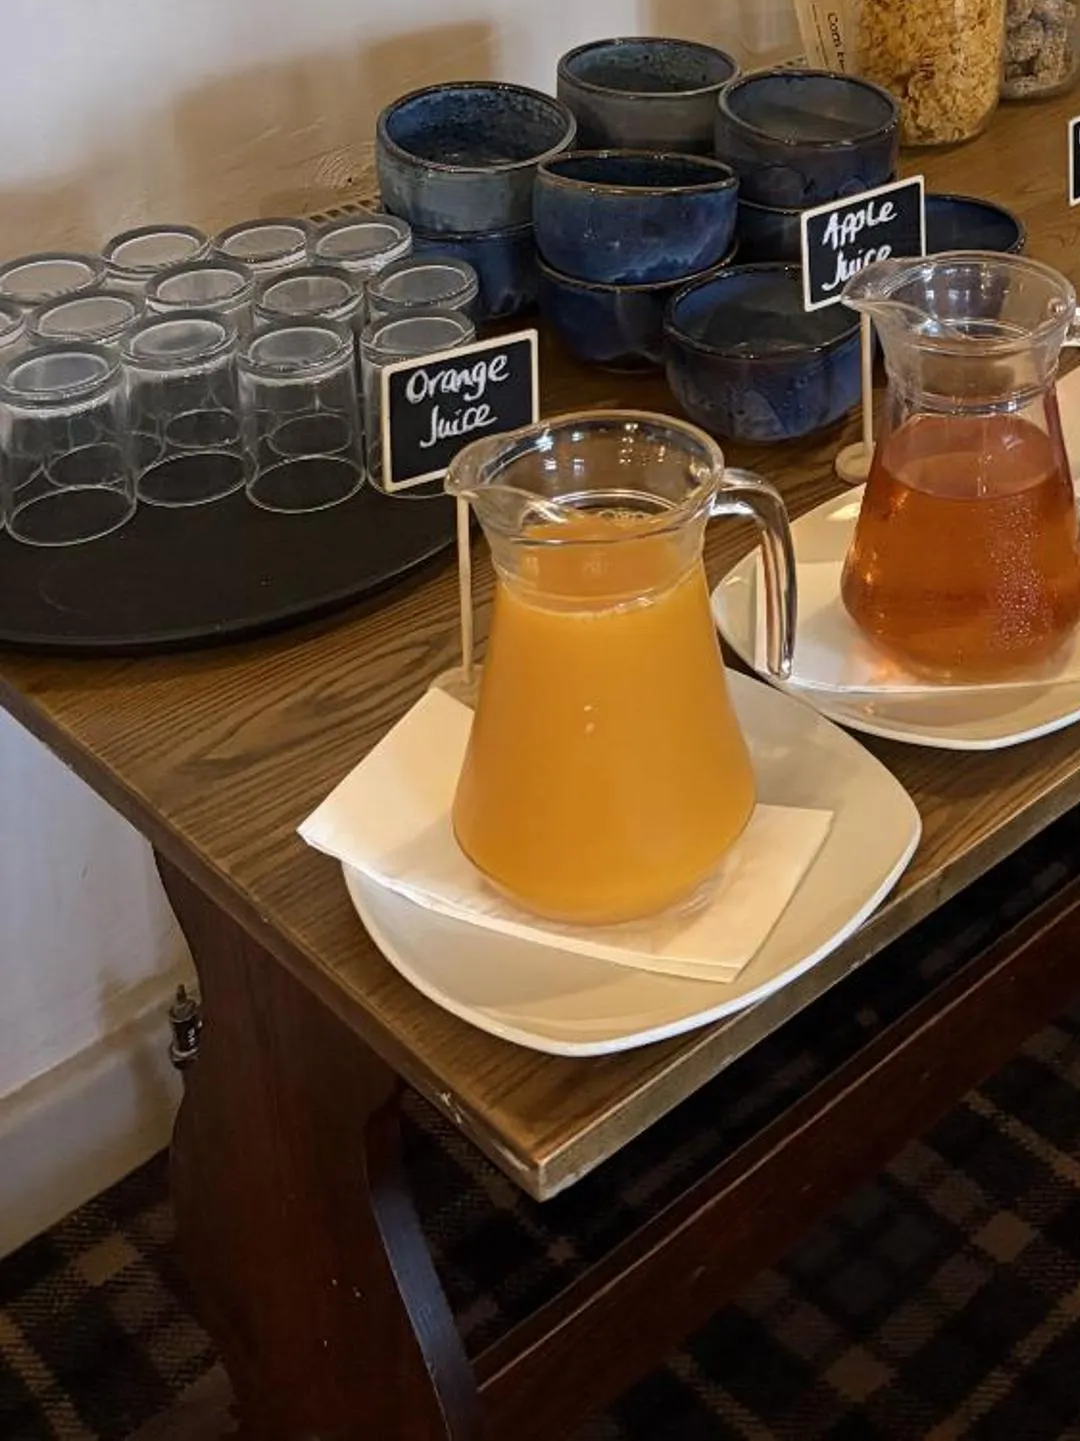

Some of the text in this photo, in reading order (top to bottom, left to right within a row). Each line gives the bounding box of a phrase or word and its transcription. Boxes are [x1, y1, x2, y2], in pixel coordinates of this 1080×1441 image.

[821, 201, 898, 250] Apple
[405, 355, 510, 404] Orange
[419, 403, 498, 448] Juice
